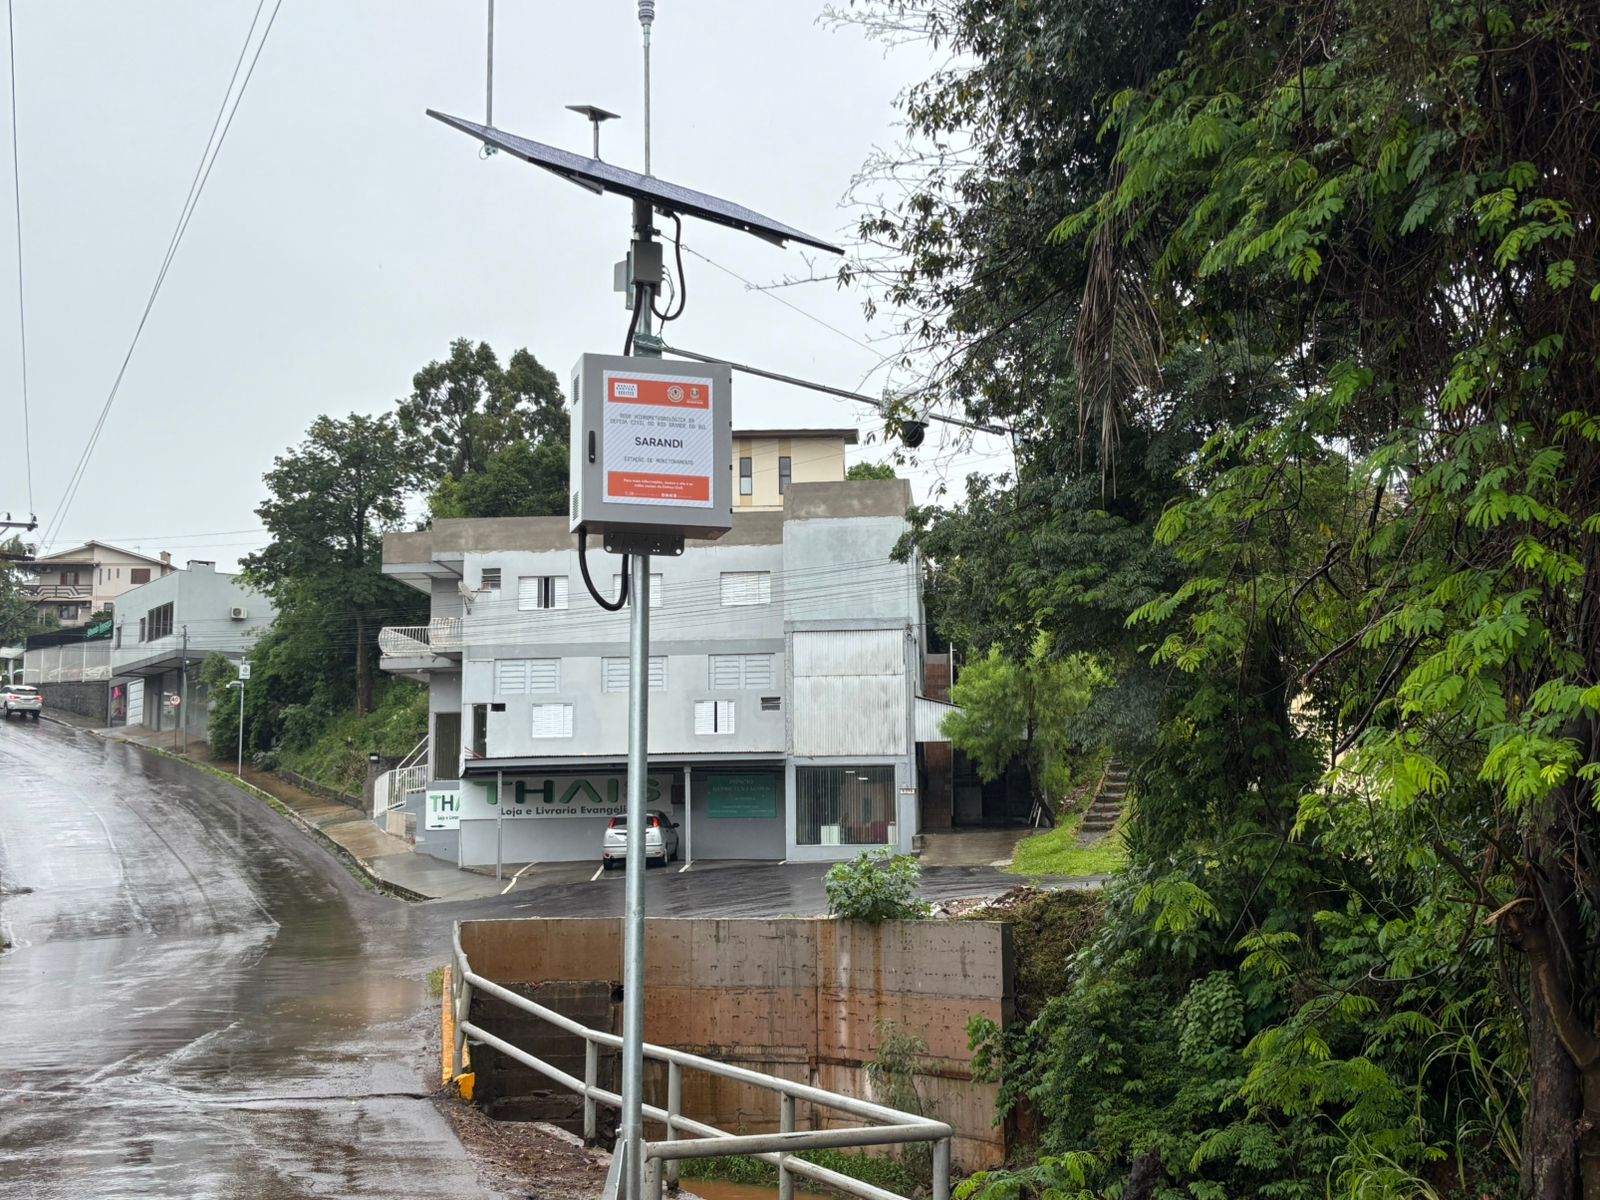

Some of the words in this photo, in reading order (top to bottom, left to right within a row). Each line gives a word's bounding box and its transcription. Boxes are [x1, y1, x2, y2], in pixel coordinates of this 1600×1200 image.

[634, 437, 683, 448] SARANDI
[501, 807, 523, 817] Loja
[536, 806, 577, 815] Livraria
[580, 805, 627, 816] Evangéli
